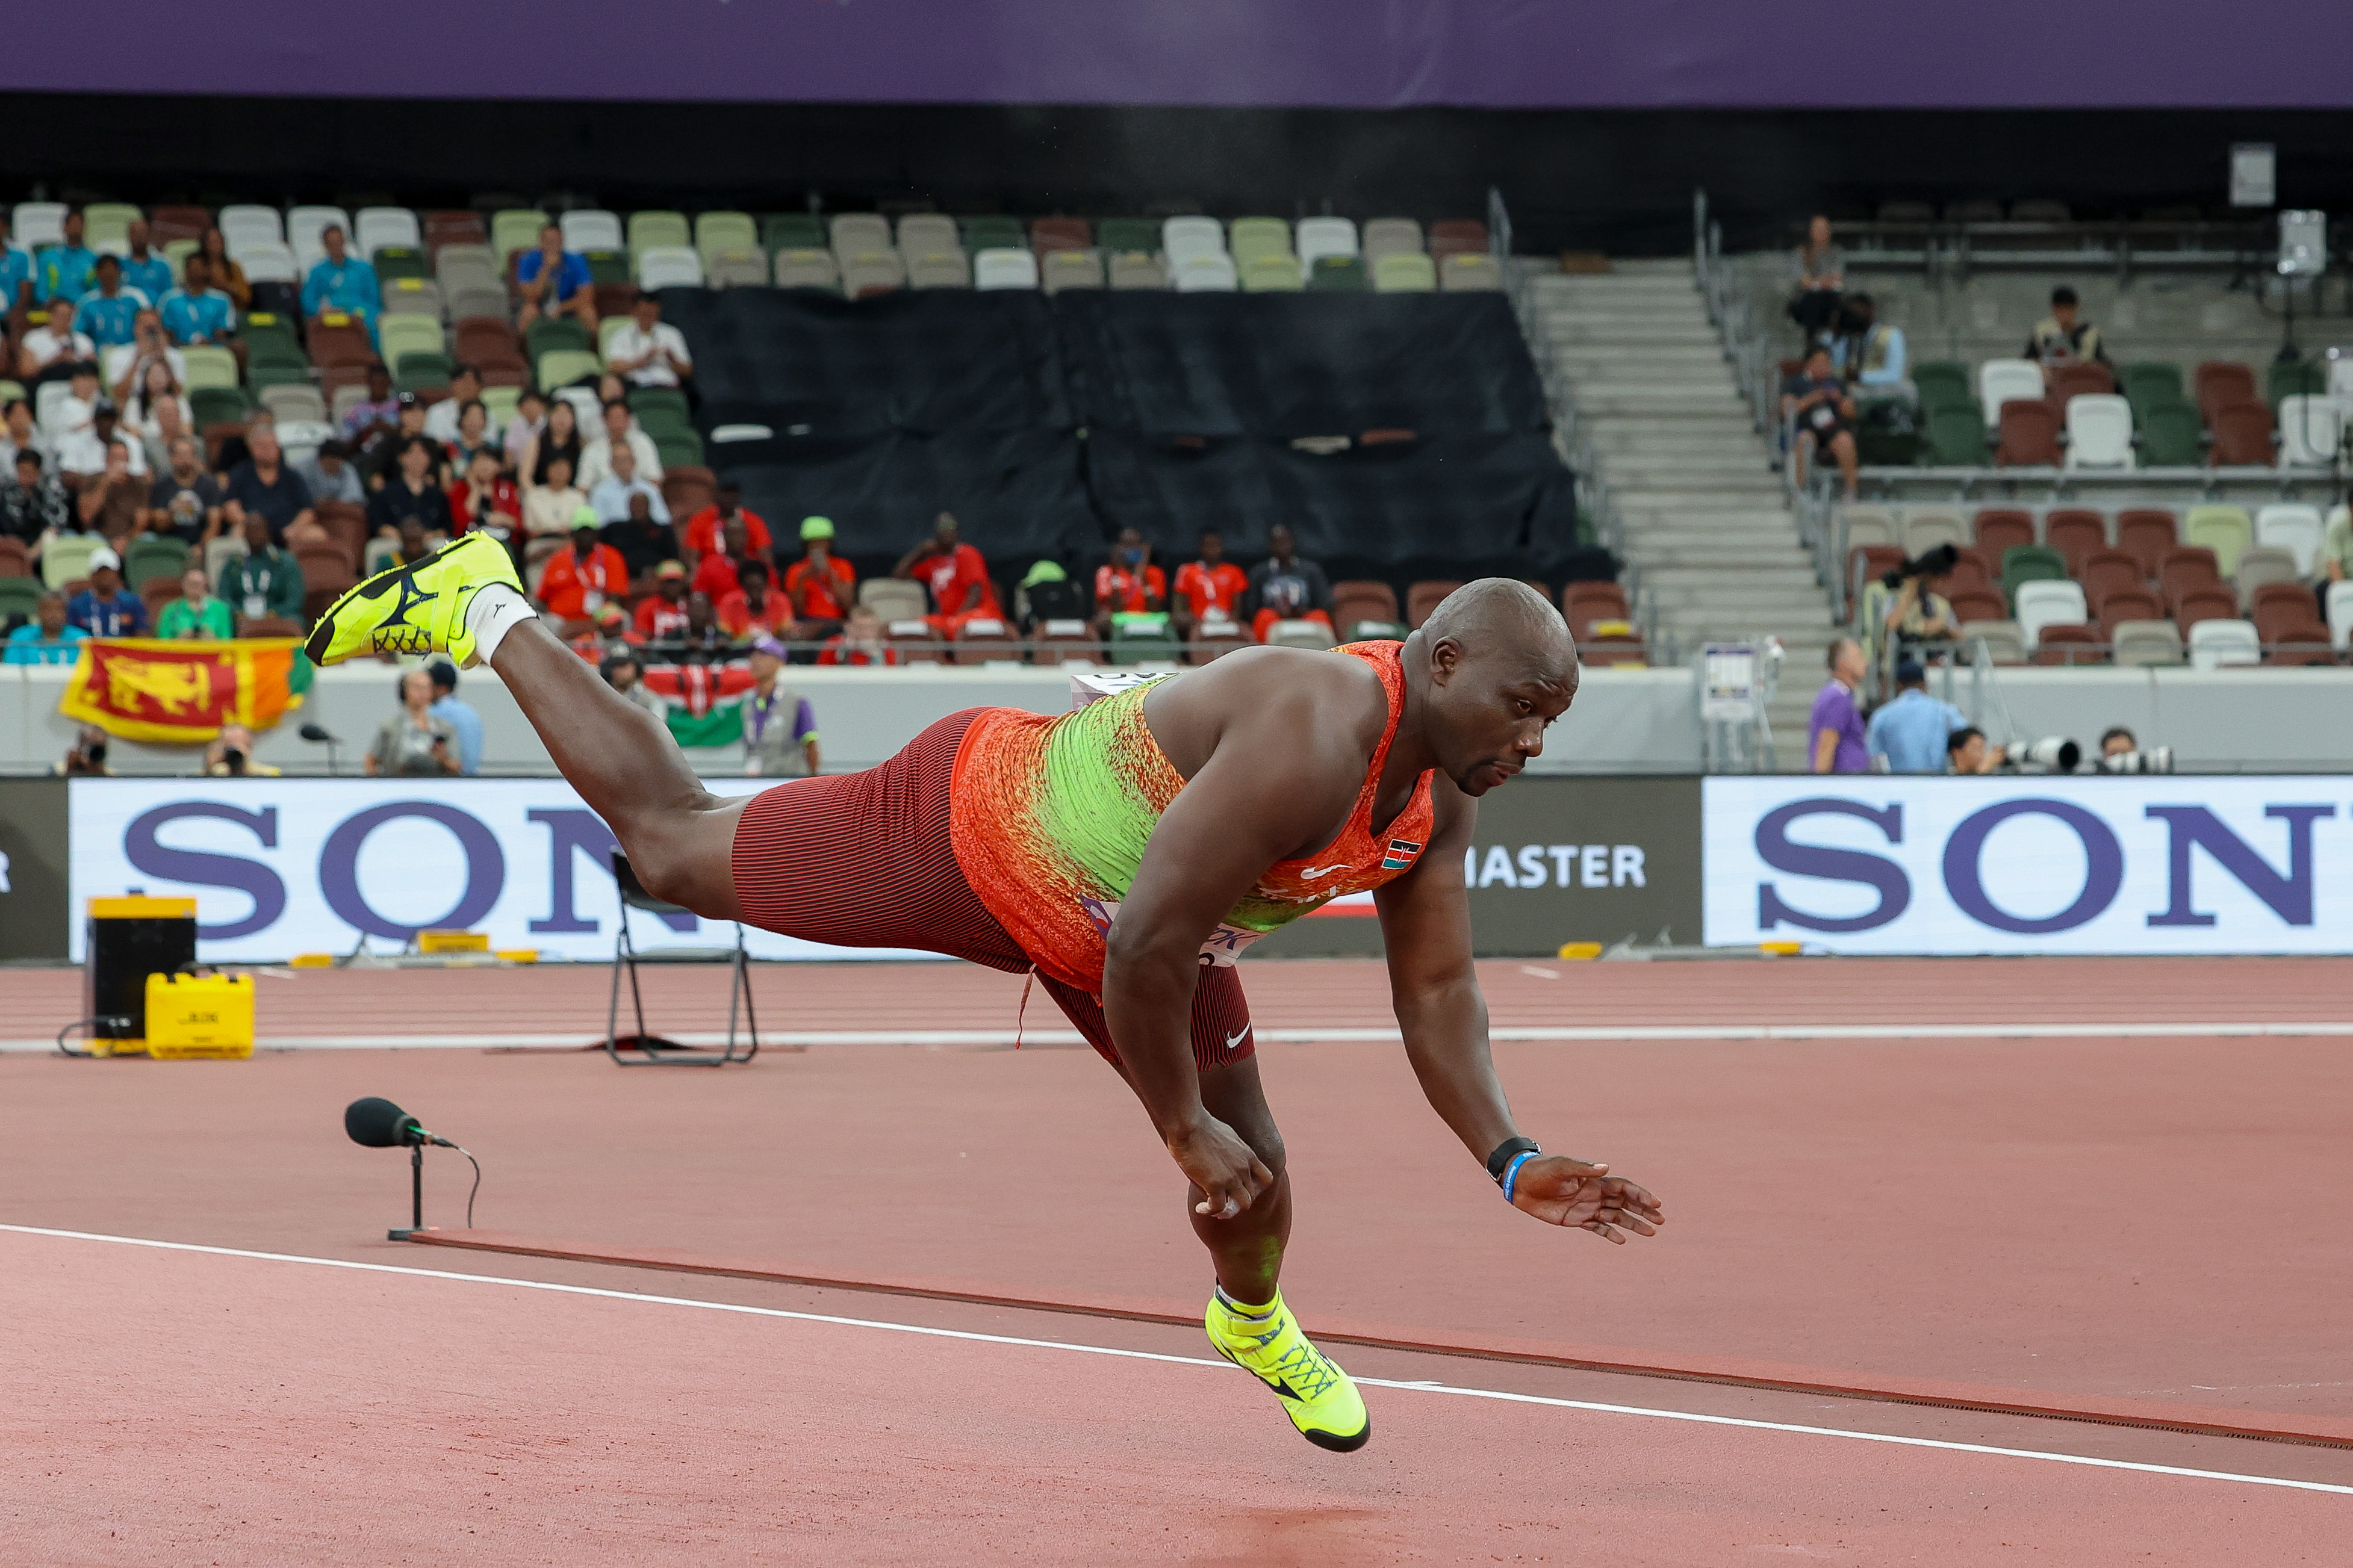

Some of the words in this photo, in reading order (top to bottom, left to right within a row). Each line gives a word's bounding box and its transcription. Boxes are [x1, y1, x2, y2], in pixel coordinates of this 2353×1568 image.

[125, 799, 697, 941] SON
[1755, 797, 2353, 934] SON
[1205, 928, 1260, 950] DK
